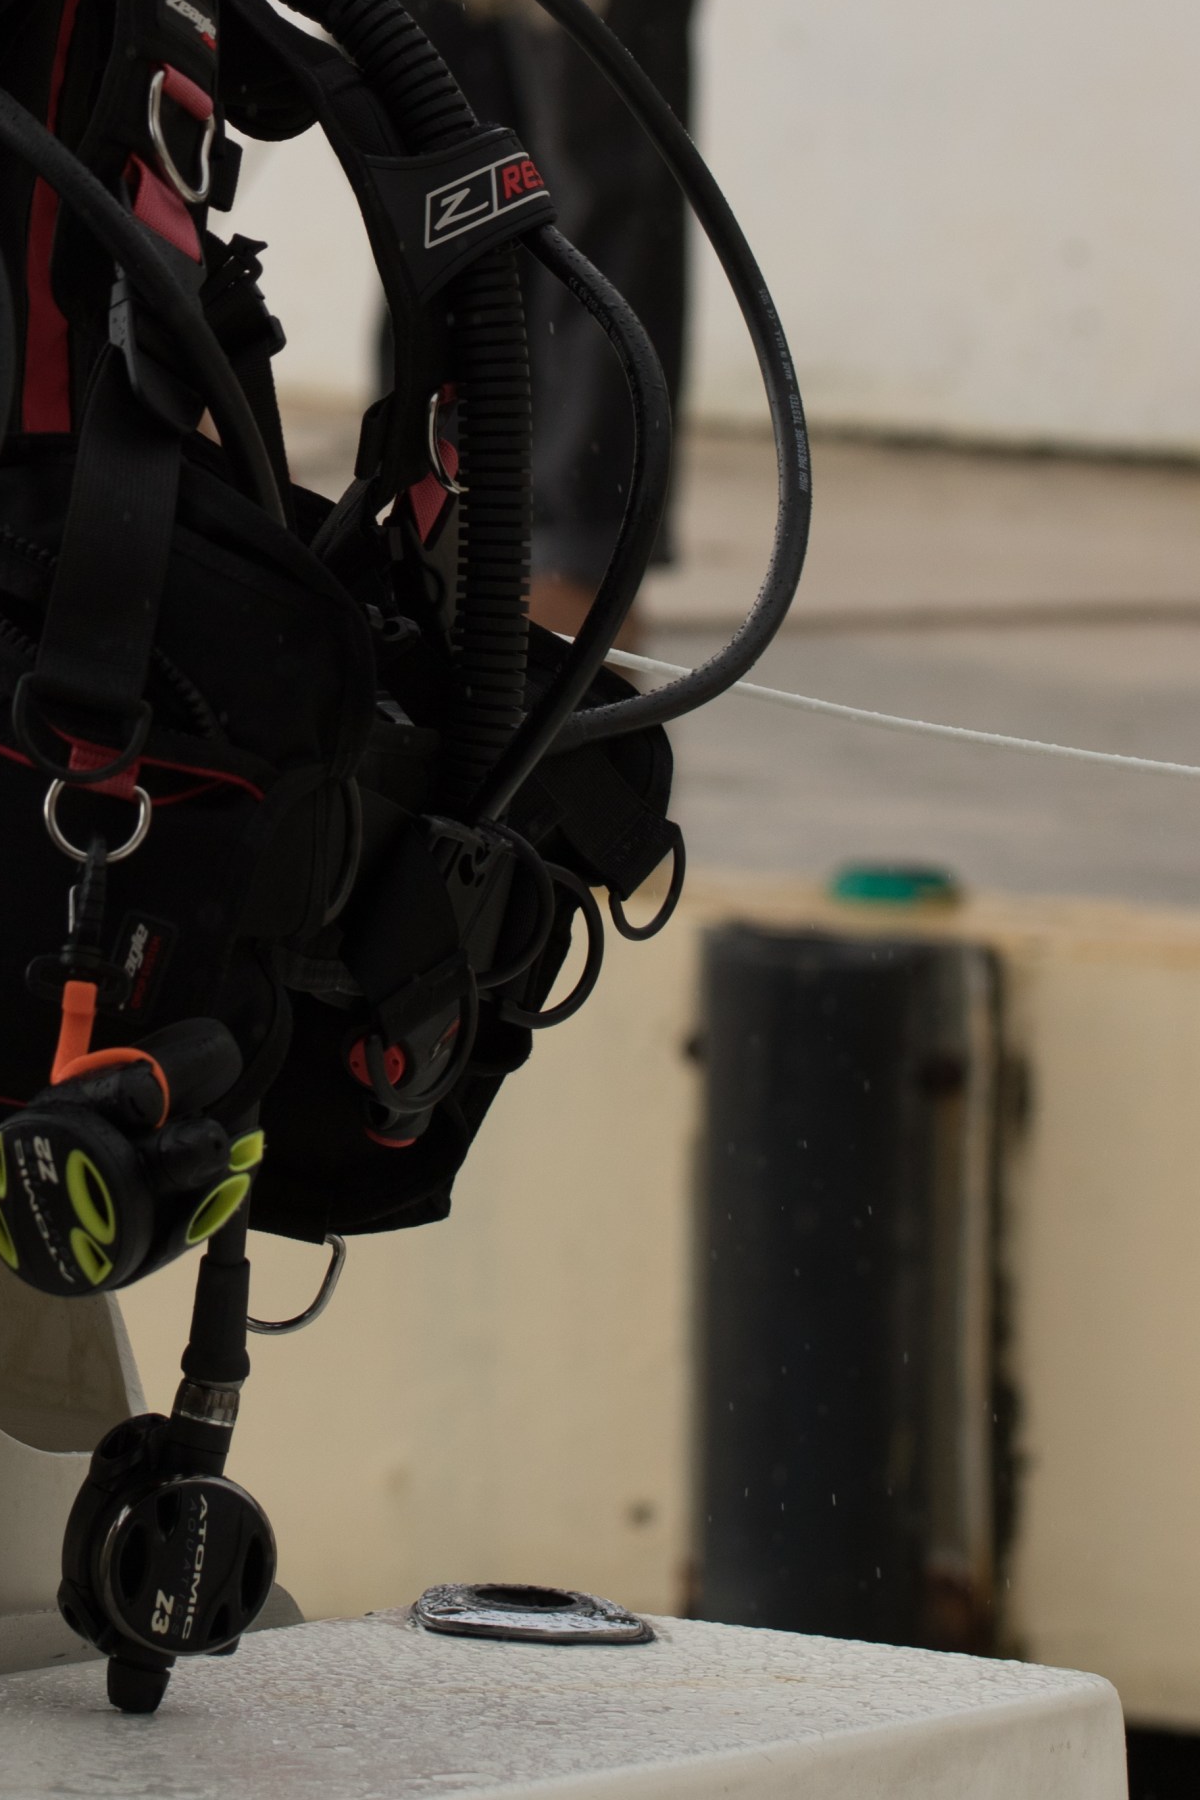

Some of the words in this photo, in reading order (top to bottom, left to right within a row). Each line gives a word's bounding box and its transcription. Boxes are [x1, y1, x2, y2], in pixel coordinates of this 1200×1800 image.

[433, 187, 490, 232] Z
[784, 359, 792, 381] MADE
[789, 393, 802, 425] TESTED
[796, 428, 808, 470] PRESSURE
[799, 472, 808, 492] HIGH
[13, 1137, 76, 1284] ATOMIC
[181, 1493, 209, 1640] ATOMIC
[151, 1588, 175, 1635] Z3
